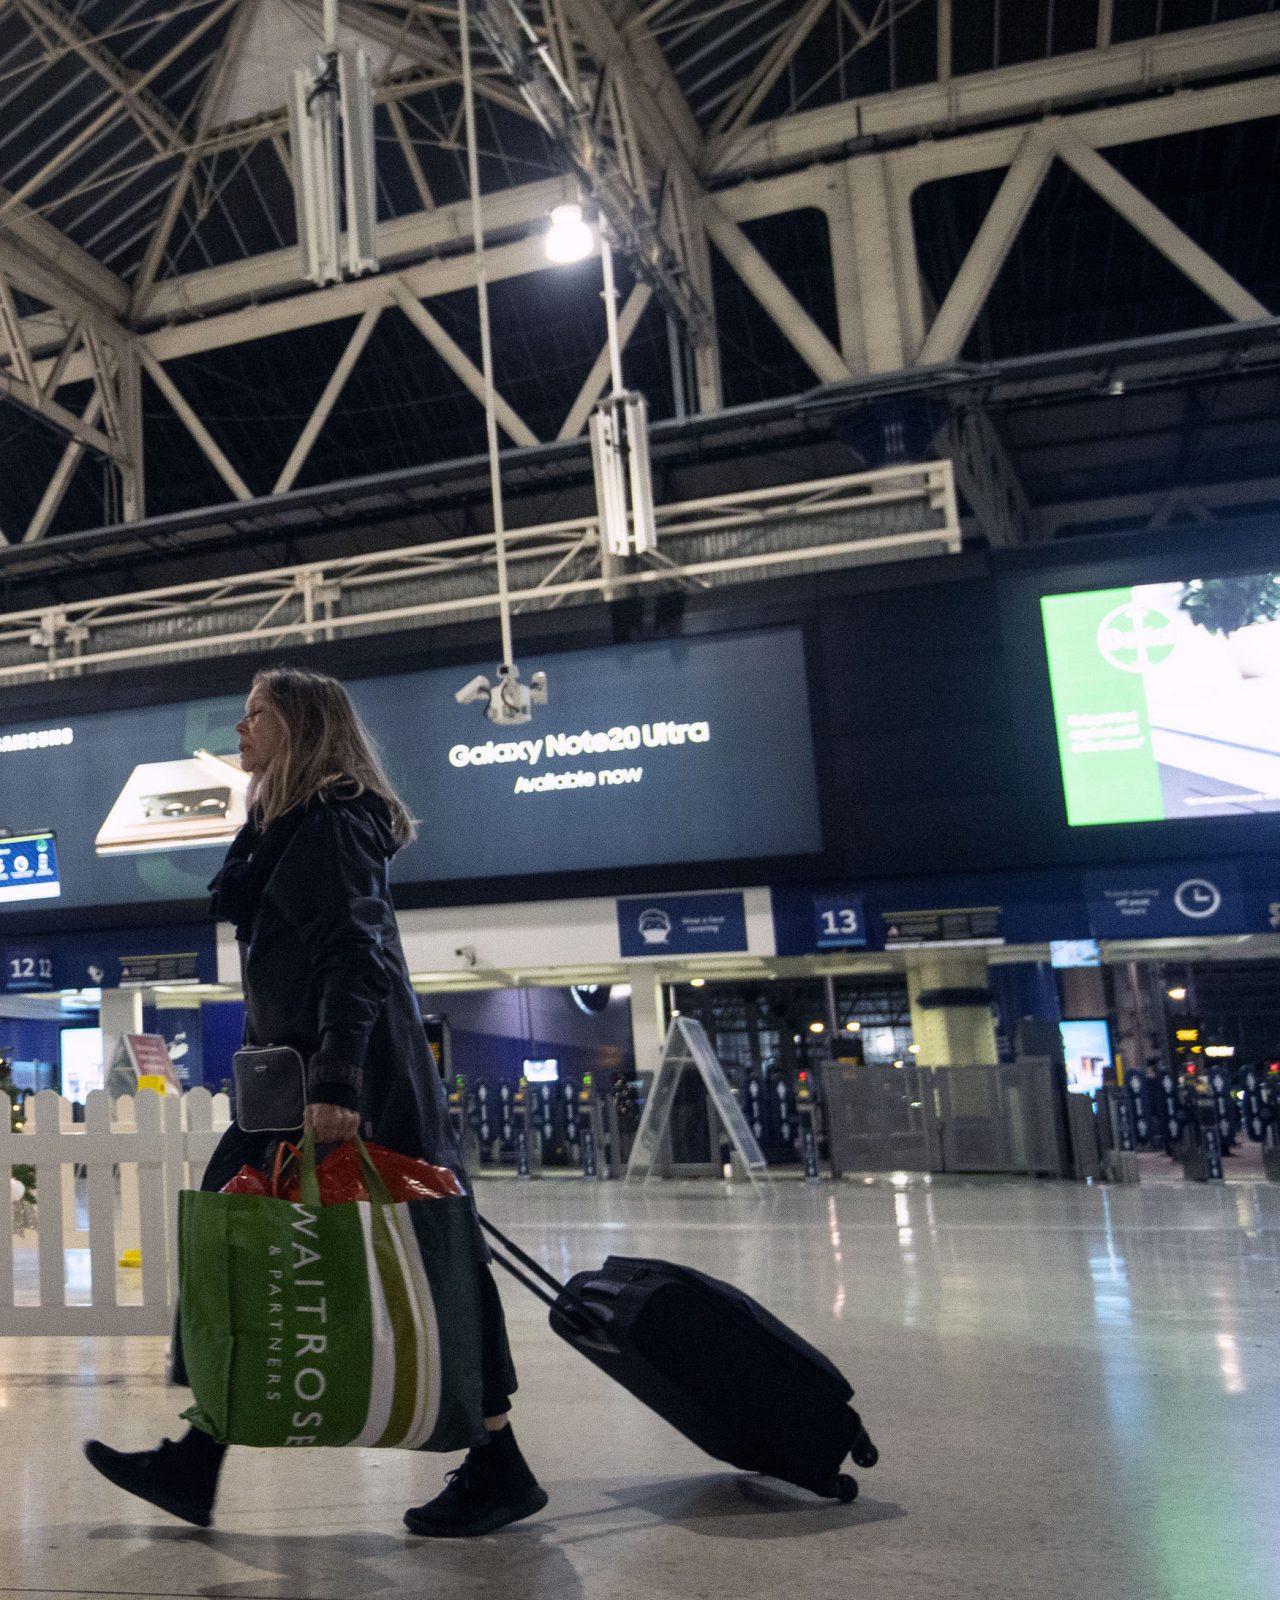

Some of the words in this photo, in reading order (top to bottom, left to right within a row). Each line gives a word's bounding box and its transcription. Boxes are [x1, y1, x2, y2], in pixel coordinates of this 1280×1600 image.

[449, 739, 544, 767] Galaxy
[546, 726, 641, 758] Note20
[641, 721, 711, 748] Ultra
[514, 770, 597, 794] Available
[598, 767, 644, 786] now
[820, 908, 858, 935] 13
[10, 957, 36, 978] 12
[267, 1246, 282, 1256] &
[266, 1269, 284, 1402] PARTNERS
[285, 1202, 327, 1446] WAITROSE
